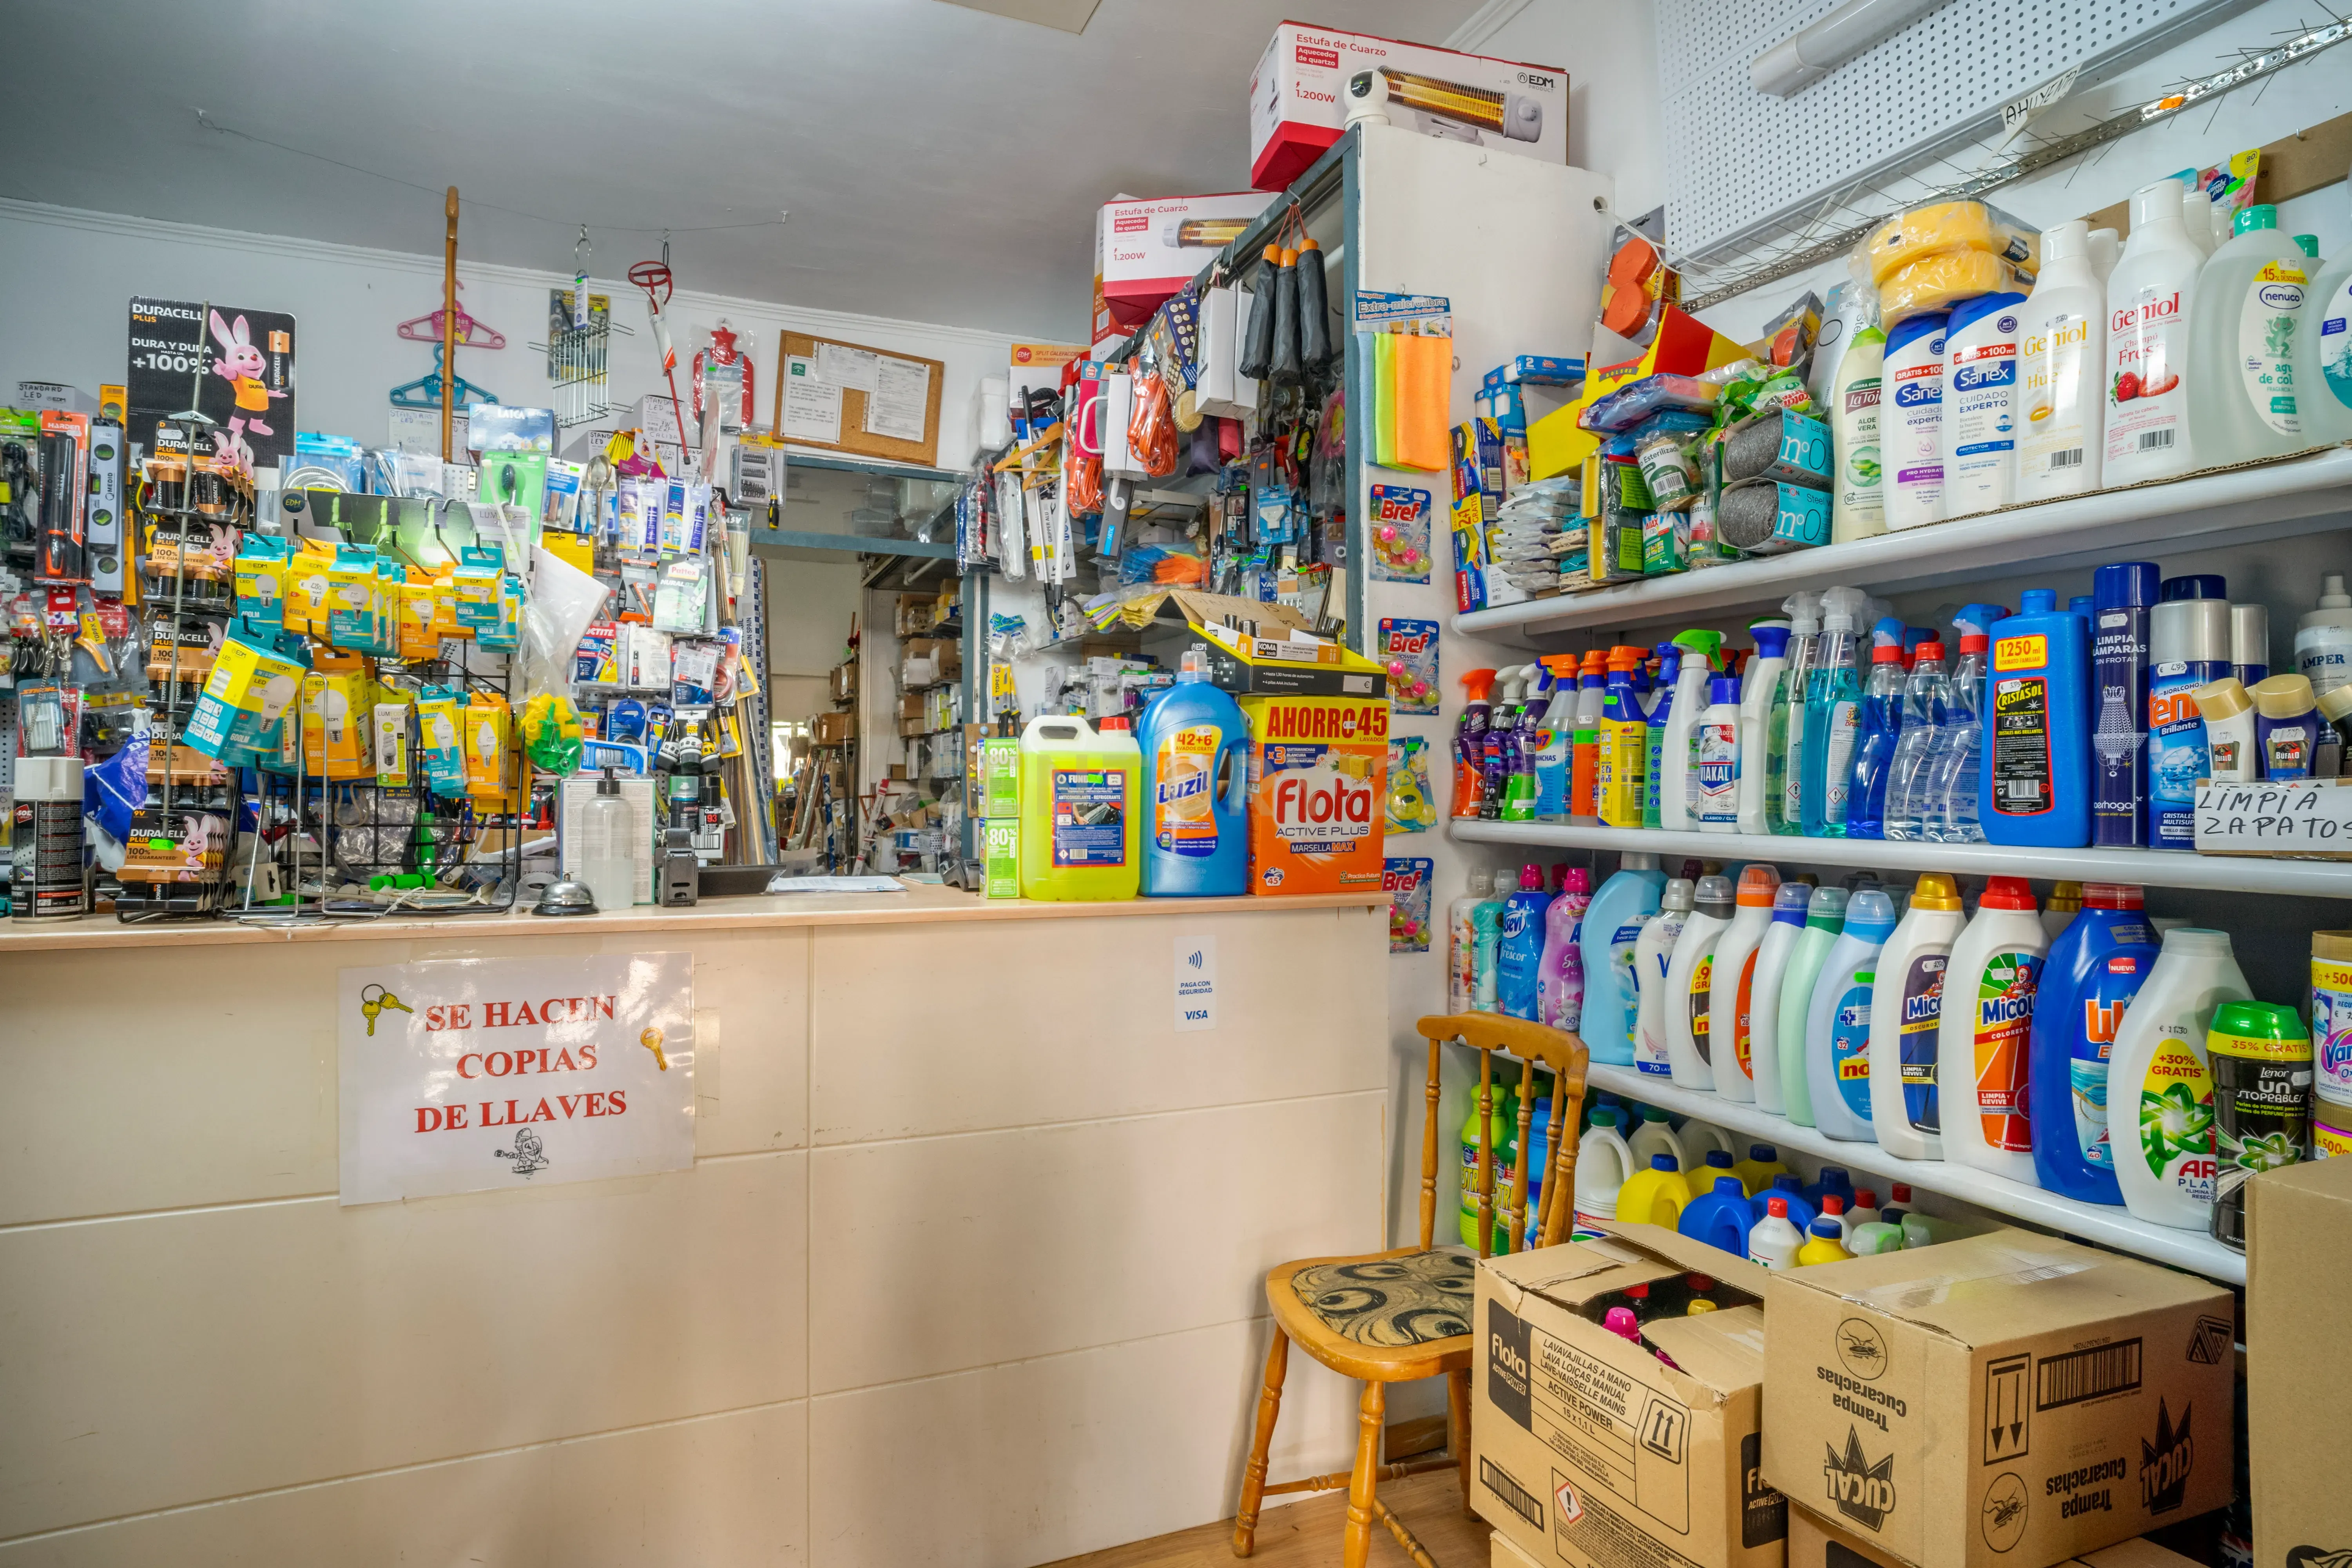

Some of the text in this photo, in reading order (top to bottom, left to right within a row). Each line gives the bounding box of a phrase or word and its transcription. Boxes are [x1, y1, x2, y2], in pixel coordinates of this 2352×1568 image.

[1297, 34, 1386, 56] Estufa de Cuarzo
[1298, 47, 1336, 58] Aquecedor
[1308, 57, 1335, 66] quartzo
[1528, 74, 1554, 88] EDM
[1296, 89, 1335, 103] 1.200W
[1528, 85, 1555, 93] PRODUCT
[1114, 207, 1144, 217] Estufa
[1157, 204, 1188, 213] Cuarzo
[1116, 219, 1147, 228] Aquecedor
[1113, 251, 1146, 261] 1.200W
[2266, 293, 2300, 302] nenuco
[132, 304, 203, 321] DURACELL
[133, 314, 156, 323] PLUS
[2112, 291, 2179, 332] Geniol
[132, 338, 177, 350] DURA Y
[2024, 321, 2088, 357] Geniol
[1605, 367, 1633, 379] BOLSAS
[1897, 369, 1922, 380] GRATIS
[1960, 368, 2009, 386] Sanex
[19, 383, 63, 392] STANDARD
[1960, 391, 2008, 404] CUIDADO
[1959, 400, 2008, 413] EXPERTO
[1785, 412, 1805, 425] AKRON
[1810, 422, 1828, 435] Lana
[1779, 486, 1800, 497] AKRON
[1806, 492, 1823, 505] Steel
[1381, 499, 1421, 522] Bref
[1645, 517, 1659, 530] AJAX
[671, 566, 697, 575] Pattex
[1460, 574, 1468, 606] vileda
[90, 624, 100, 642] TOPEX
[2097, 634, 2135, 645] LIMPIA
[1258, 643, 1276, 651] KOMA
[1389, 633, 1430, 654] Bref
[2093, 645, 2146, 656] LÁMPARAS
[2301, 654, 2345, 670] AMPER
[2163, 681, 2203, 696] BIOALCOHOL
[1997, 685, 2043, 711] CRISTASOL
[1267, 707, 1387, 739] AHORRO 45
[2161, 721, 2198, 735] Brillante
[1177, 733, 1212, 746] 42+6
[1700, 766, 1729, 782] VIAKAL
[1159, 770, 1208, 804] Luzil
[1276, 778, 1371, 824] Flota
[2093, 800, 2136, 812] aerhogar
[2198, 789, 2318, 814] LIMPIA
[707, 814, 718, 822] 93
[1276, 826, 1369, 837] ACTIVE PLUS
[128, 848, 150, 856] 100%
[1382, 870, 1422, 892] Bref
[426, 995, 616, 1032] SE HACEN
[1184, 1010, 1208, 1020] VISA
[1909, 1021, 1938, 1031] OSCUROS
[1991, 1028, 2024, 1040] COLORES
[2231, 1040, 2259, 1051] 35%
[457, 1045, 597, 1079] COPIAS
[2158, 1055, 2196, 1066] +30%
[2260, 1067, 2289, 1079] Lenor
[2237, 1091, 2304, 1103] STOPPABLES
[415, 1090, 627, 1133] DE LLAVES
[1492, 1333, 1526, 1380] Flota
[1543, 1339, 1631, 1392] LAVAVAJILLAS A MANO
[1492, 1363, 1526, 1396] ACTIVE POWER
[1542, 1349, 1626, 1403] LAVA LOIÇAS MANUAL
[1540, 1358, 1626, 1416] LAVE-VAISSELLE MAINS
[1817, 1366, 1907, 1418] Cucarachas
[1548, 1381, 1613, 1430] ACTIVE POWER
[1833, 1393, 1889, 1432] Trampa
[1563, 1407, 1571, 1418] 15
[1578, 1417, 1588, 1429] 1,1
[1590, 1424, 1595, 1435] L
[1581, 1449, 1597, 1464] PERSÁN
[1585, 1464, 1614, 1487] www.persan.es
[1591, 1463, 1609, 1478] SEVILLA
[2046, 1457, 2126, 1496] Cucarachas
[1825, 1467, 1894, 1513] CUCAL
[2062, 1488, 2112, 1519] Trampa
